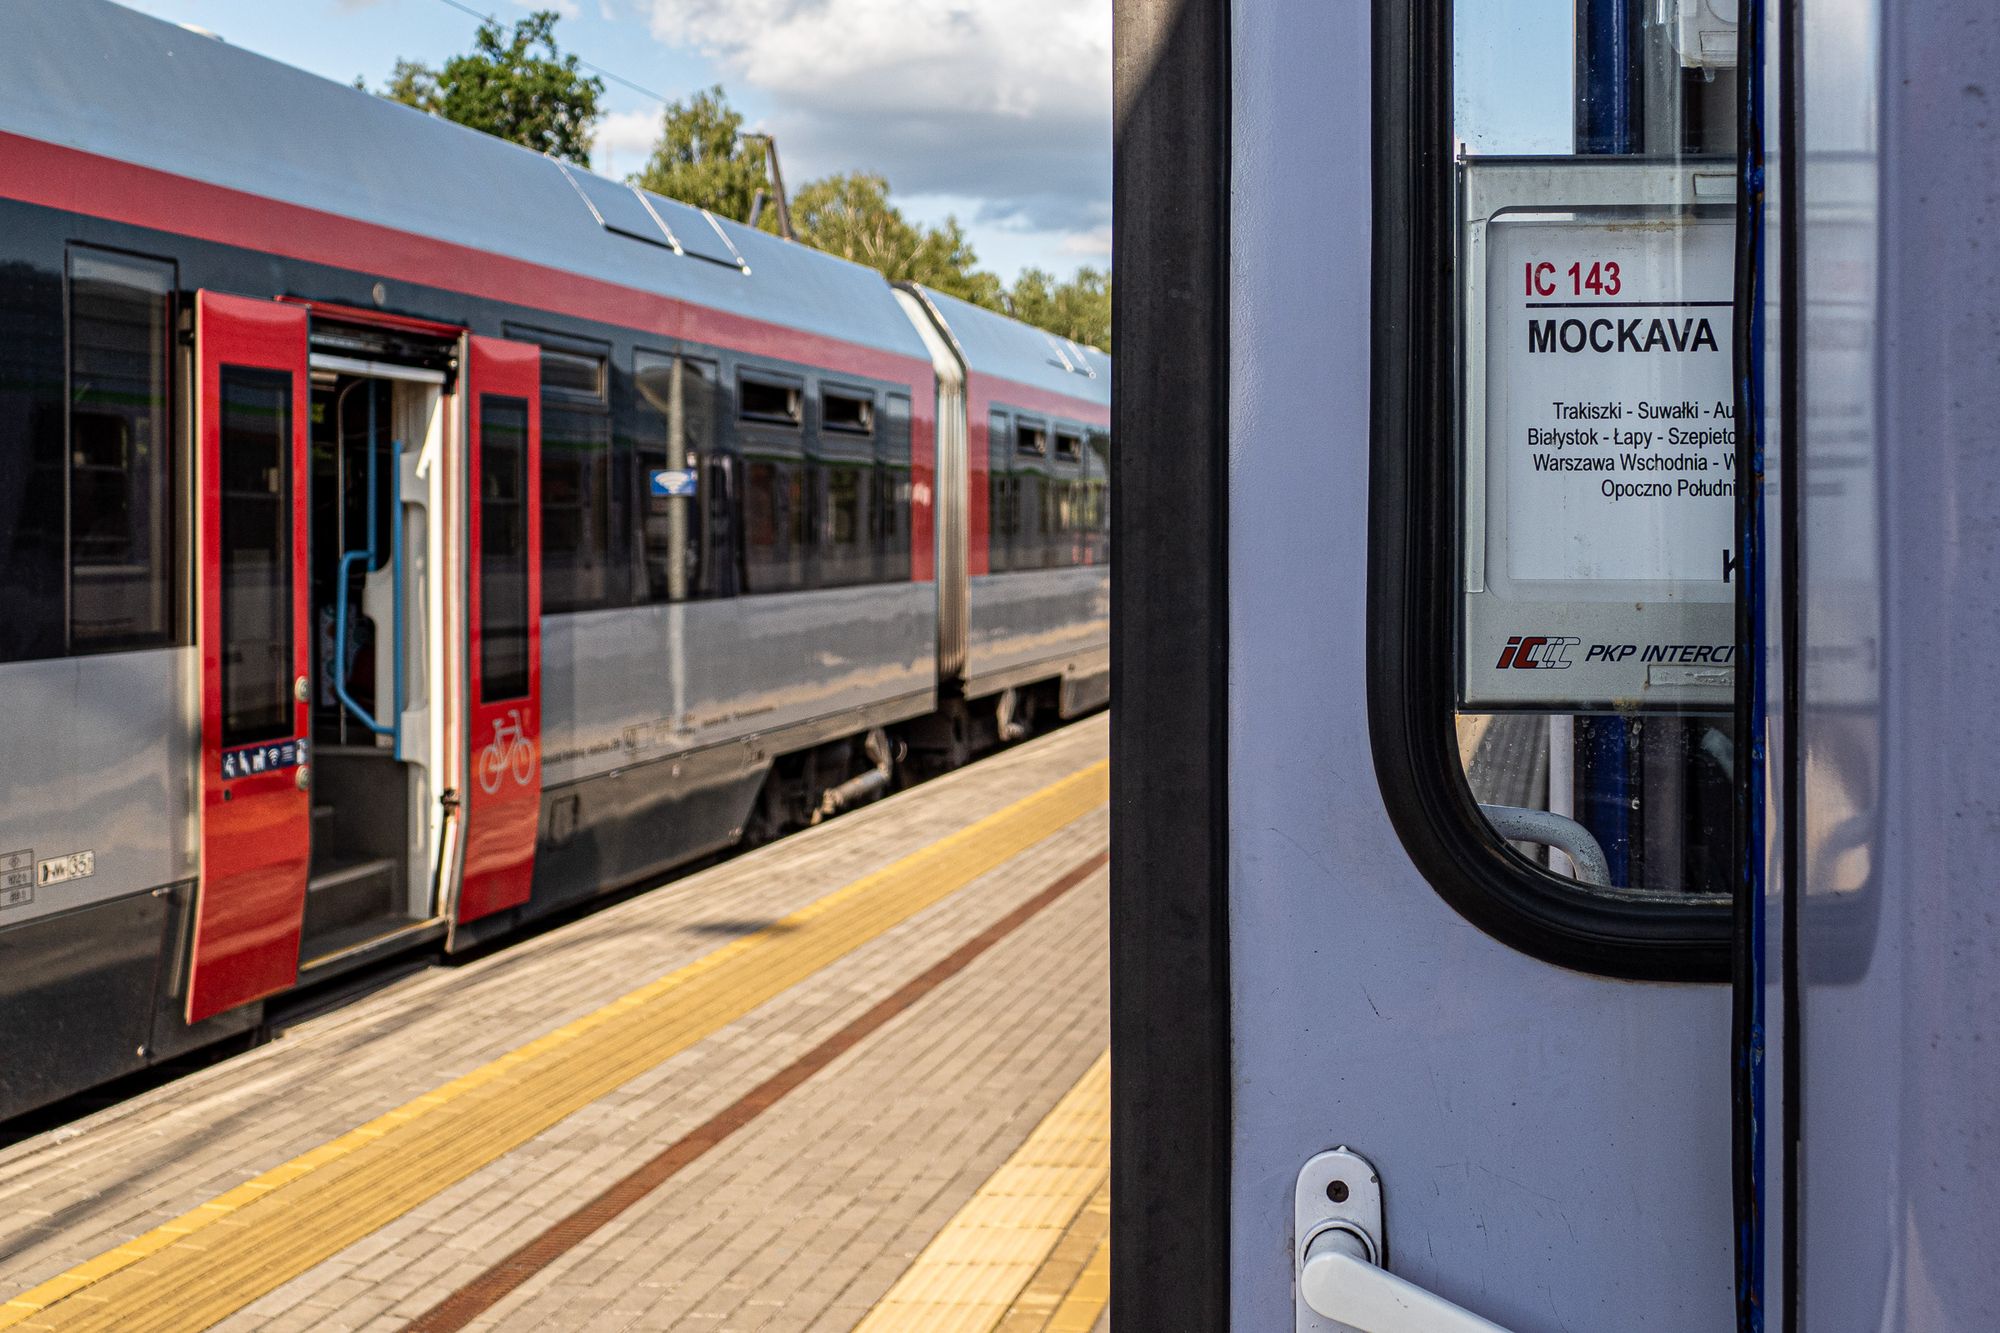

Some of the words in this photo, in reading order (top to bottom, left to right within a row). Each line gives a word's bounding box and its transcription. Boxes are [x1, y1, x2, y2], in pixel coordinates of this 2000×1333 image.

[1525, 262, 1556, 297] IC
[1568, 261, 1622, 296] 143
[1528, 318, 1719, 354] MOCKAVA
[1552, 401, 1622, 420] Trakiszki
[1637, 400, 1699, 420] Suwałki
[1528, 427, 1599, 449] Białystok
[1613, 428, 1653, 450] Łapy
[1668, 426, 1735, 449] Szepieto
[1532, 453, 1615, 472] Warszawa
[1620, 452, 1708, 472] Wschodnia
[1601, 479, 1673, 502] Opoczno
[1585, 644, 1637, 663] PKP
[1640, 644, 1736, 663] INTERCI
